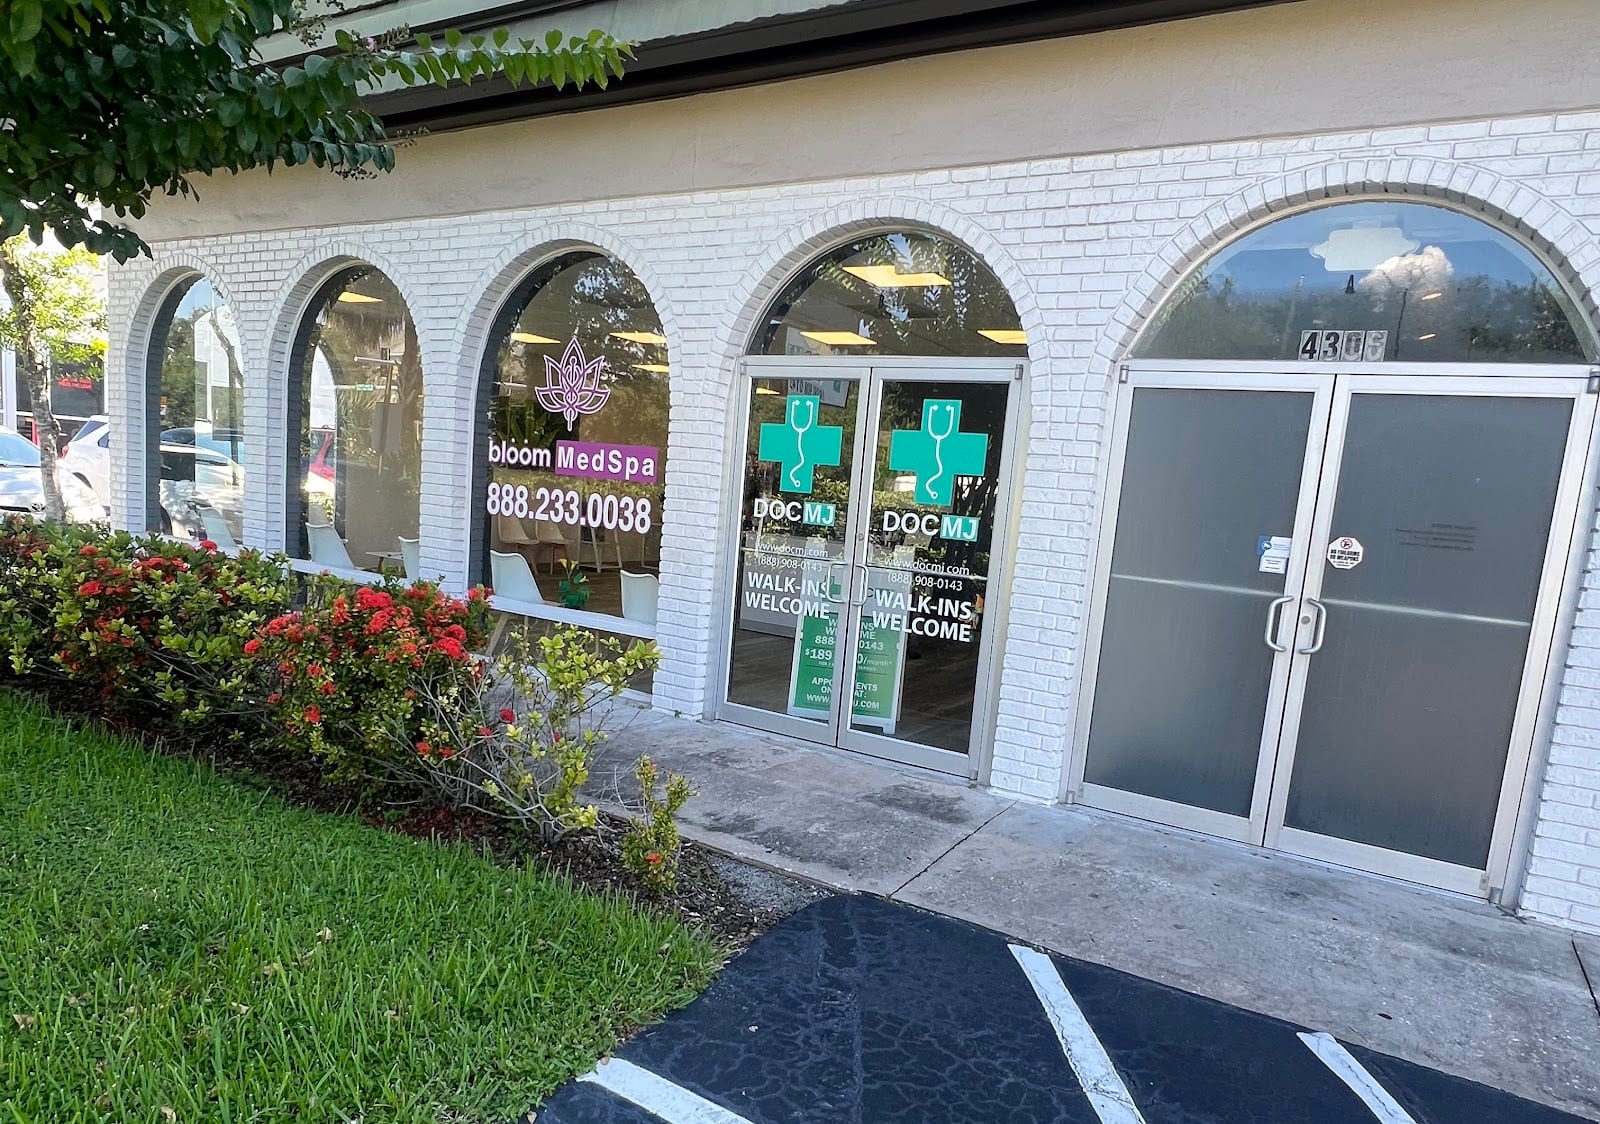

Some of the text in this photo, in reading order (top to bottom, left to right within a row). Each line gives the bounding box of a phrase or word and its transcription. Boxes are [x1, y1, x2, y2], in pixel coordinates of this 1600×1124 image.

[488, 440, 655, 479] bloom MedSpa
[486, 482, 651, 534] 888.233.0038
[757, 543, 828, 558] www.docmj.com
[884, 557, 970, 576] www.docmj.com
[748, 571, 827, 598] WALK-INS
[887, 573, 963, 591] (888) 908-0143
[745, 591, 830, 619] WELCOME
[876, 589, 972, 619] WALK-INS
[872, 610, 971, 642] WELCOME
